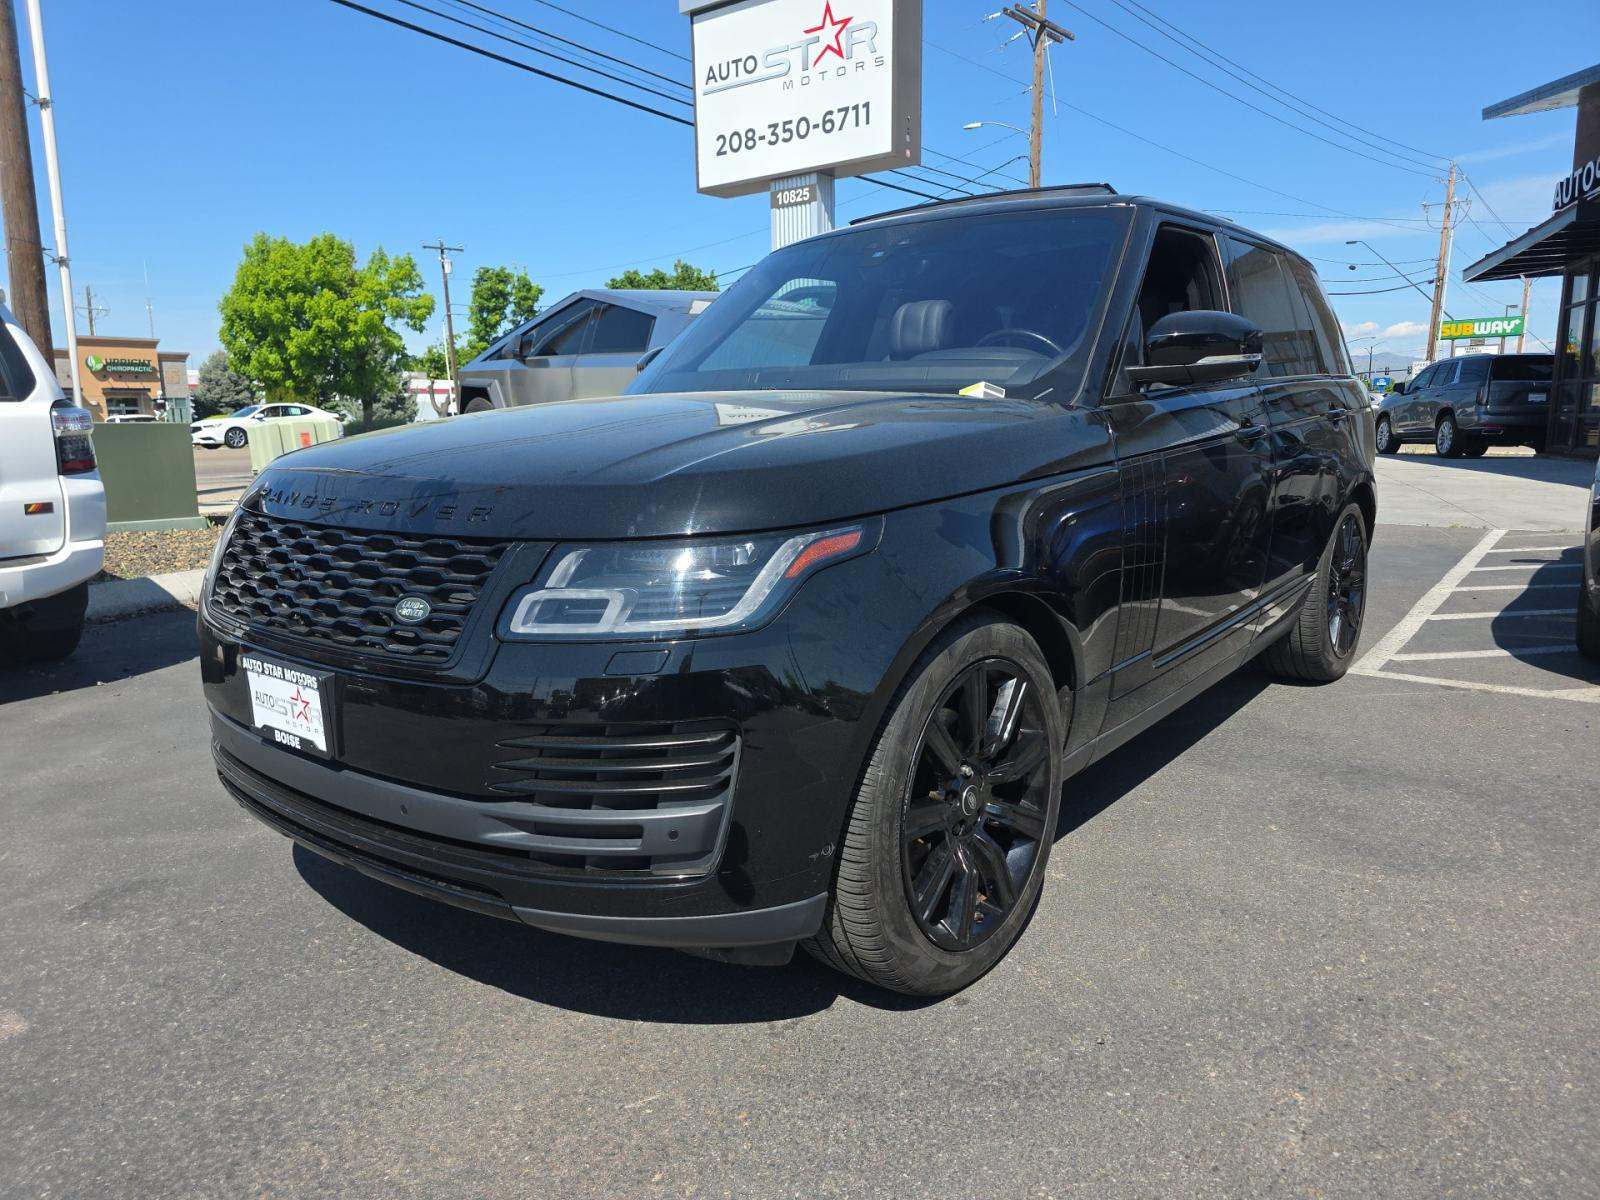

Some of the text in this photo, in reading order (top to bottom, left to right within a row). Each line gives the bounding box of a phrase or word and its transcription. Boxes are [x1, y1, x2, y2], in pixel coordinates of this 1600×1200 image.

[705, 55, 758, 85] AUTO
[782, 56, 884, 91] MOTORS
[715, 101, 871, 156] 208-350-6711
[776, 187, 810, 206] 10825
[1442, 319, 1521, 337] SUBWAY
[354, 500, 495, 522] ROVER
[401, 600, 421, 609] LAND
[243, 657, 318, 688] AUTO STAR MOTORS
[255, 690, 275, 708] AUTO
[274, 729, 302, 750] BOISE
